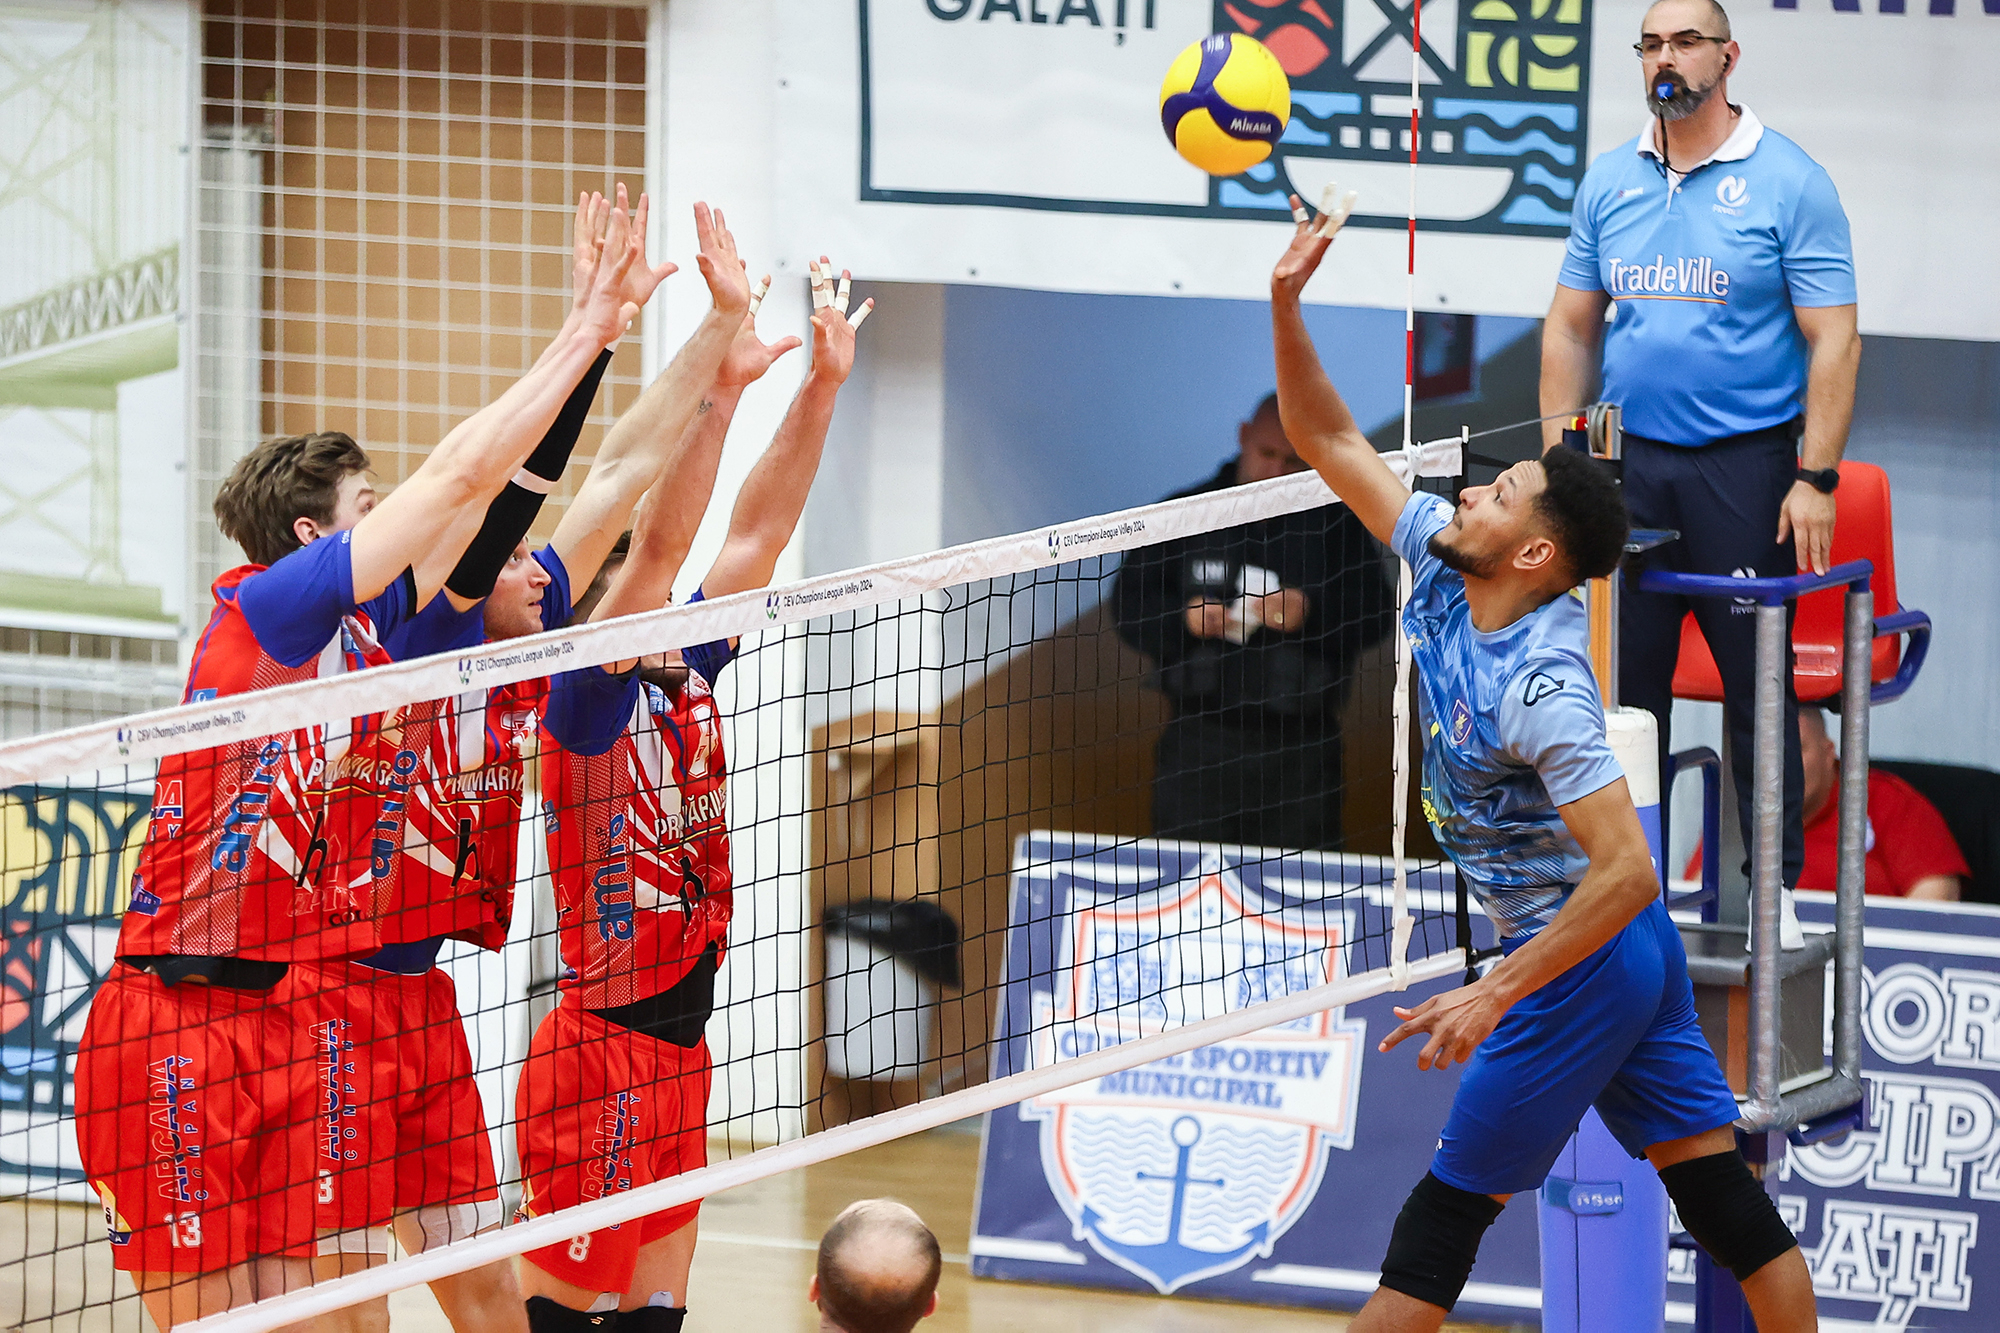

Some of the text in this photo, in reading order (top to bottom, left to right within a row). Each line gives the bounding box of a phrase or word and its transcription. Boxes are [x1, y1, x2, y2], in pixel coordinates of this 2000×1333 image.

[1608, 254, 1731, 297] TradeVille
[1063, 519, 1146, 547] CEV Champions League Volley 2024
[795, 589, 824, 606] Champions
[824, 587, 844, 601] League
[844, 583, 860, 597] Volley
[859, 578, 873, 592] 2024
[487, 653, 521, 670] Champions
[522, 649, 543, 664] League
[543, 644, 561, 659] Volley
[151, 722, 186, 740] Champions
[1191, 1046, 1331, 1080] SPORTIV
[1096, 1069, 1283, 1110] MUNICIPAL
[177, 1055, 209, 1201] COMPANY
[163, 1210, 204, 1249] 13
